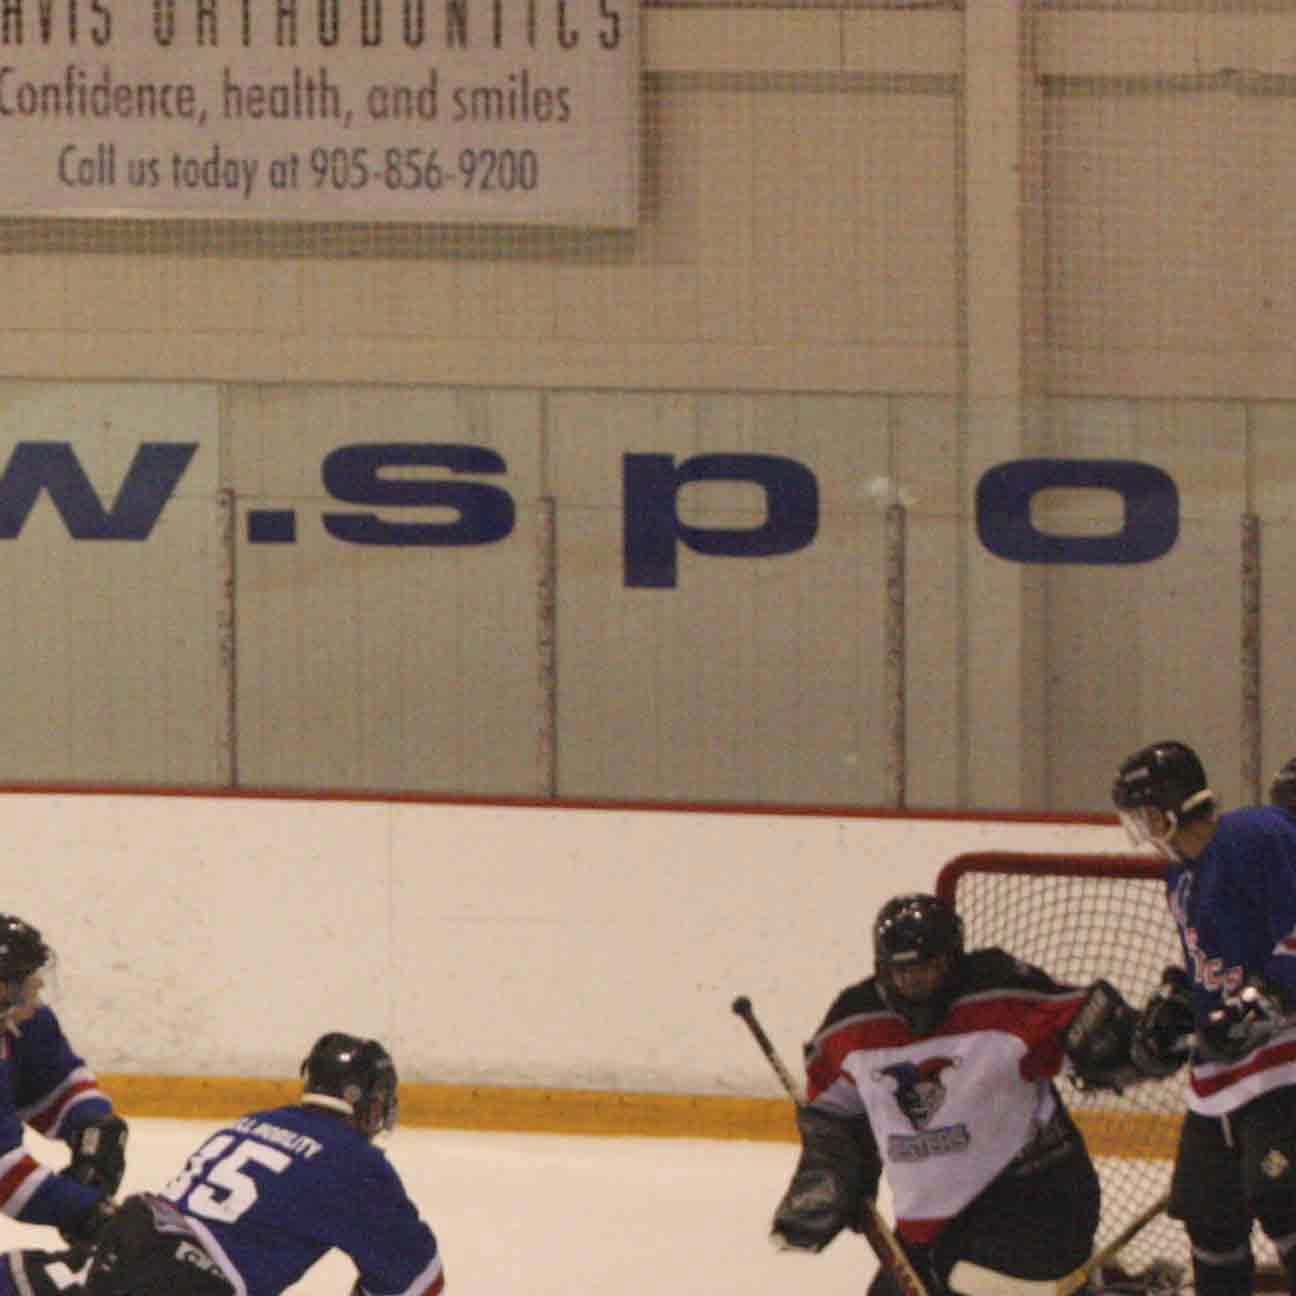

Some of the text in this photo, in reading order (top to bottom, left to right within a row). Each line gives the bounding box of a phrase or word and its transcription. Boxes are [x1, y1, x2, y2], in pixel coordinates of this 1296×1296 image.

[223, 66, 353, 128] health,
[367, 67, 438, 119] and
[452, 68, 571, 123] smiles
[58, 143, 539, 199] Call us today at 905-856-9200
